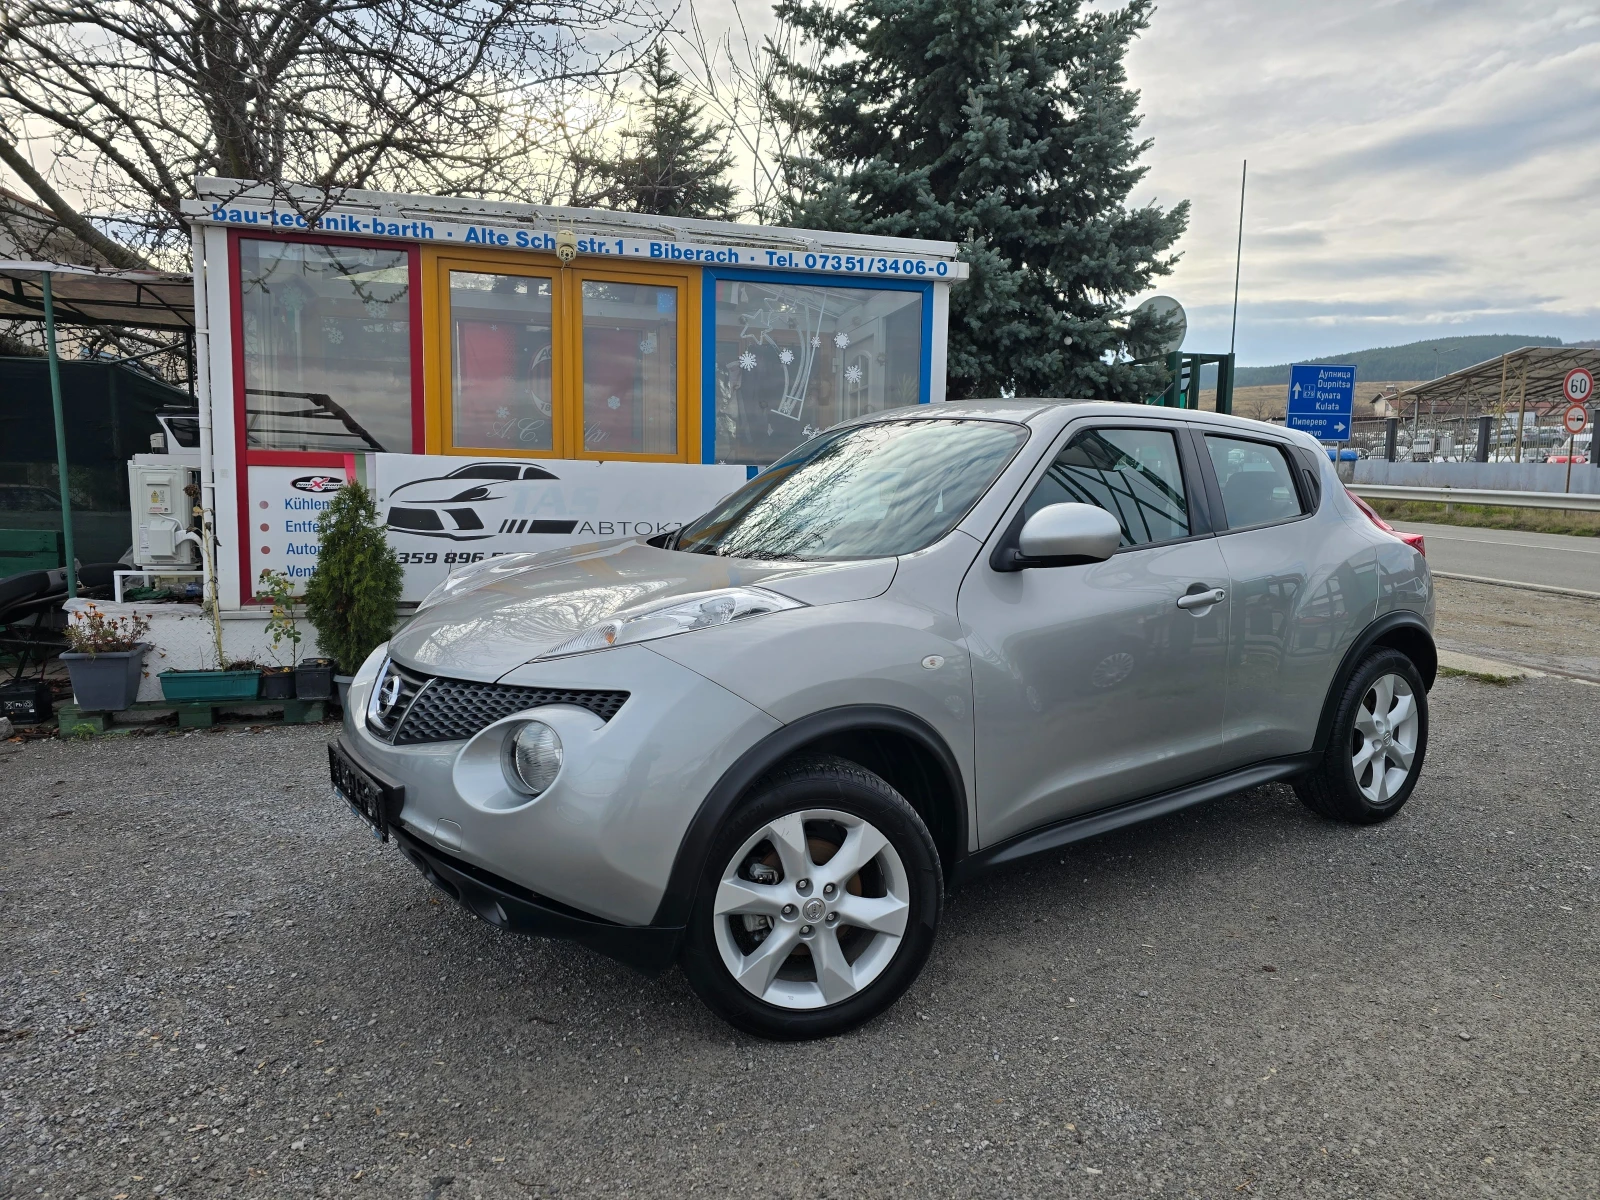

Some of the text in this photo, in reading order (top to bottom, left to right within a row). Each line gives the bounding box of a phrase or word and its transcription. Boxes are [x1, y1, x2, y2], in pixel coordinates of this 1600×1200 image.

[465, 226, 508, 246] Alte
[648, 242, 740, 264] Biberach
[765, 250, 799, 268] Tel.
[804, 253, 949, 276] 07351/3406-0
[1318, 369, 1351, 380] Дупница
[1317, 379, 1351, 390] Dupnitsa
[1570, 378, 1587, 394] 60
[1316, 391, 1341, 401] Кулата
[1315, 402, 1340, 411] Kulata
[1292, 417, 1327, 427] Пиперево
[444, 552, 484, 564] 896
[287, 565, 317, 577] Vent
